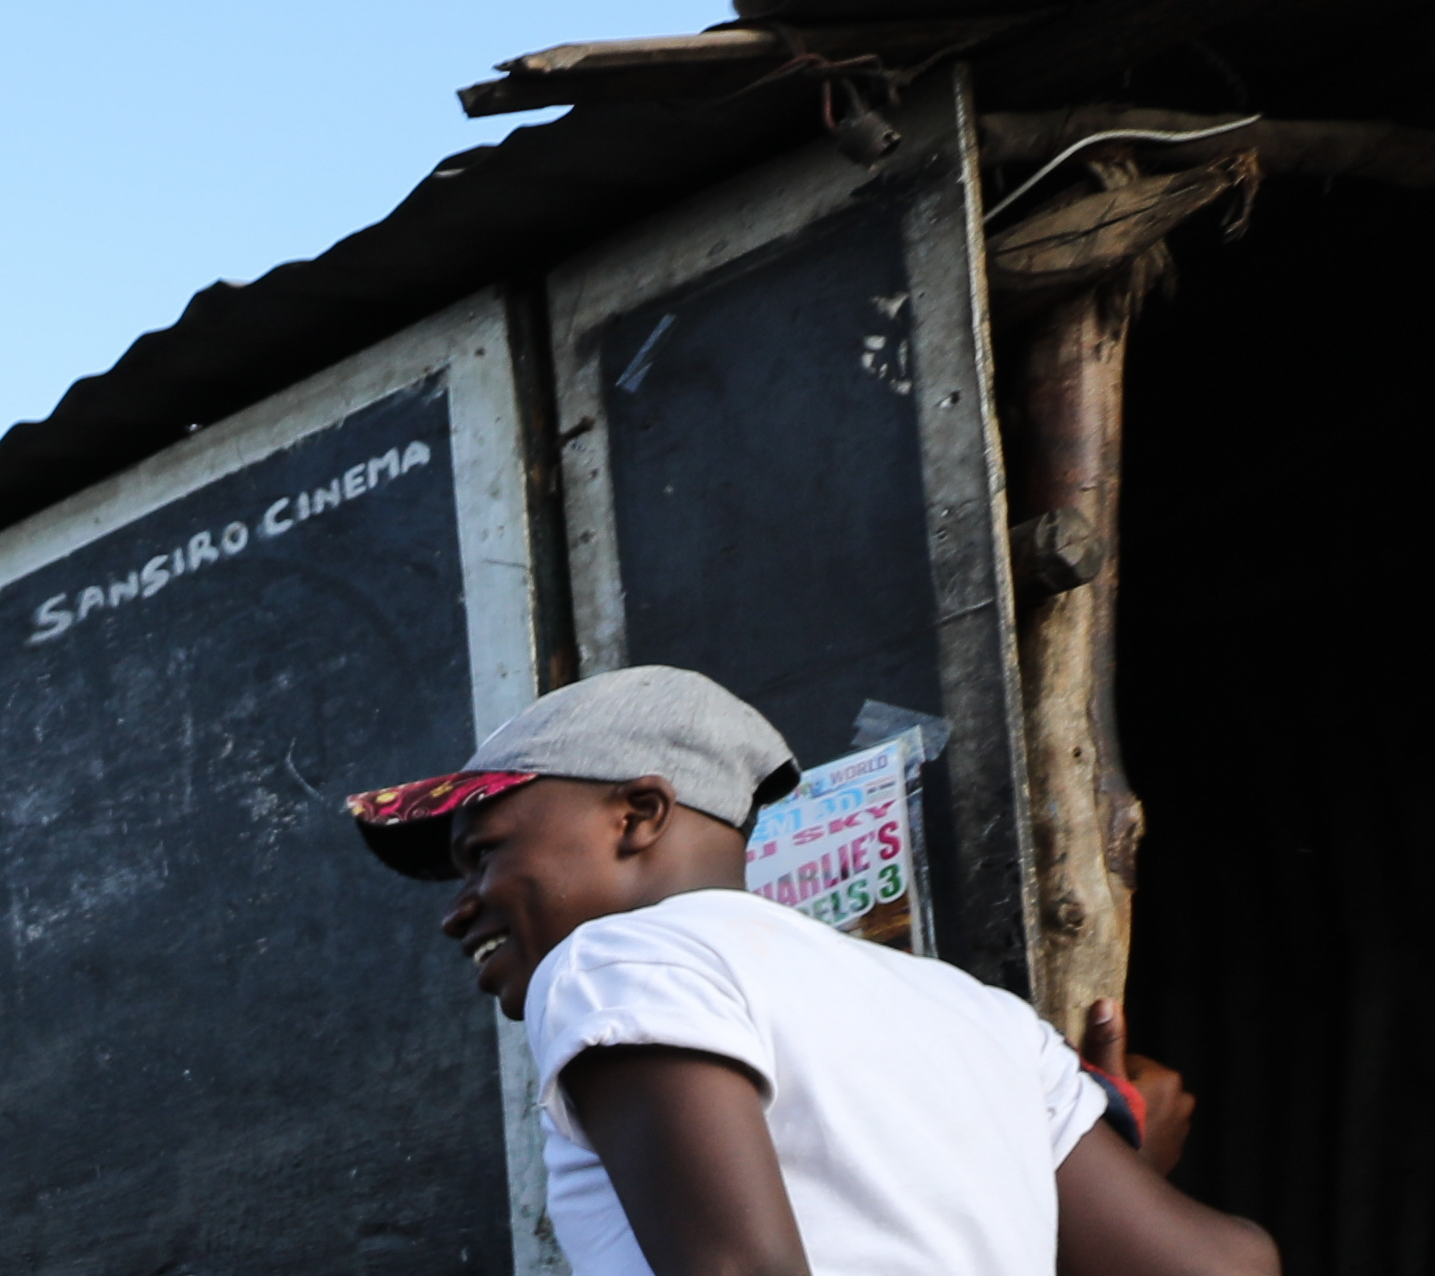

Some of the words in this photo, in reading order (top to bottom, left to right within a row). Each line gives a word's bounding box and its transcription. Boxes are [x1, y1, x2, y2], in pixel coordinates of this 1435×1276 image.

[28, 519, 250, 647] SANSIRO
[260, 438, 430, 537] CINEMA
[830, 755, 888, 785] WORLD
[792, 799, 897, 846] SKY
[752, 820, 902, 906] HARLIE'S
[878, 863, 903, 898] 3
